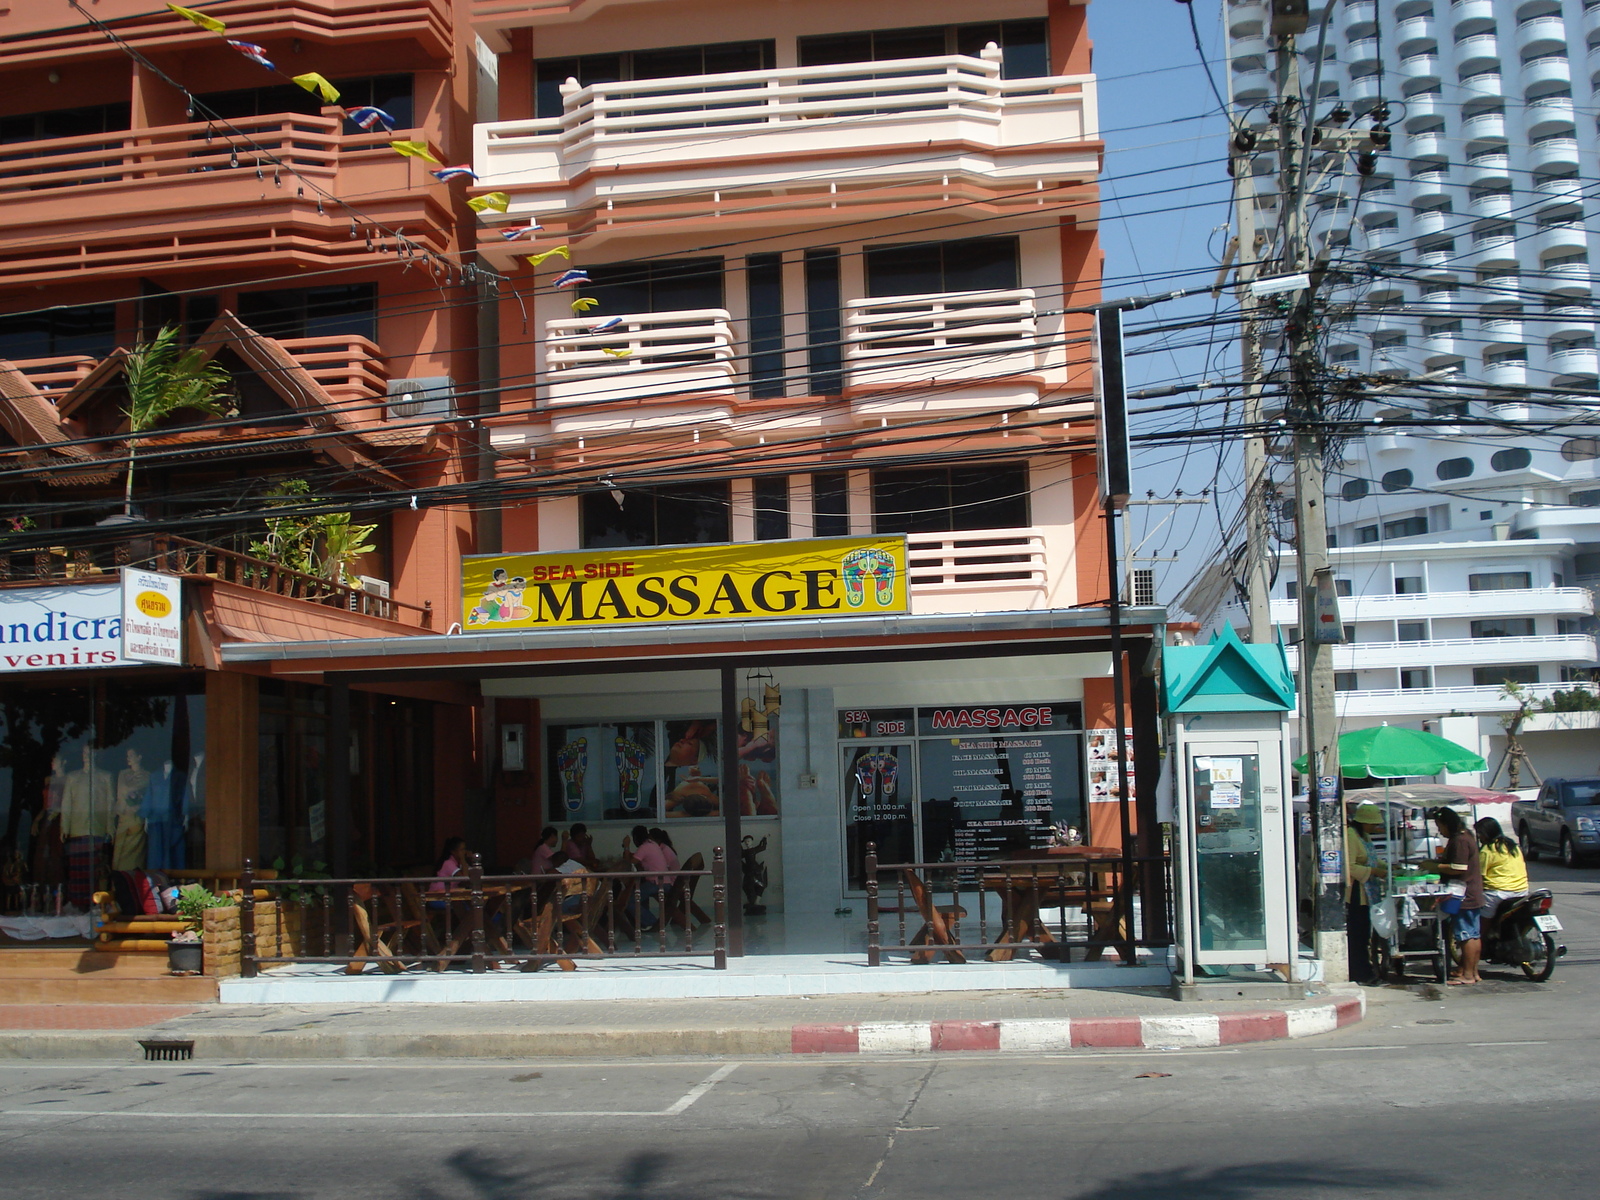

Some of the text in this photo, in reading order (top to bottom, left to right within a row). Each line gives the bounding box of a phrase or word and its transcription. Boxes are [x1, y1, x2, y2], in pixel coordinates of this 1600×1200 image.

[533, 562, 634, 581] SEA SIDE
[533, 569, 841, 622] MASSAGE
[4, 647, 116, 667] venirs
[845, 710, 905, 734] SEA SIDE
[932, 707, 1052, 728] MASSAGE
[999, 740, 1042, 748] MASSAGE
